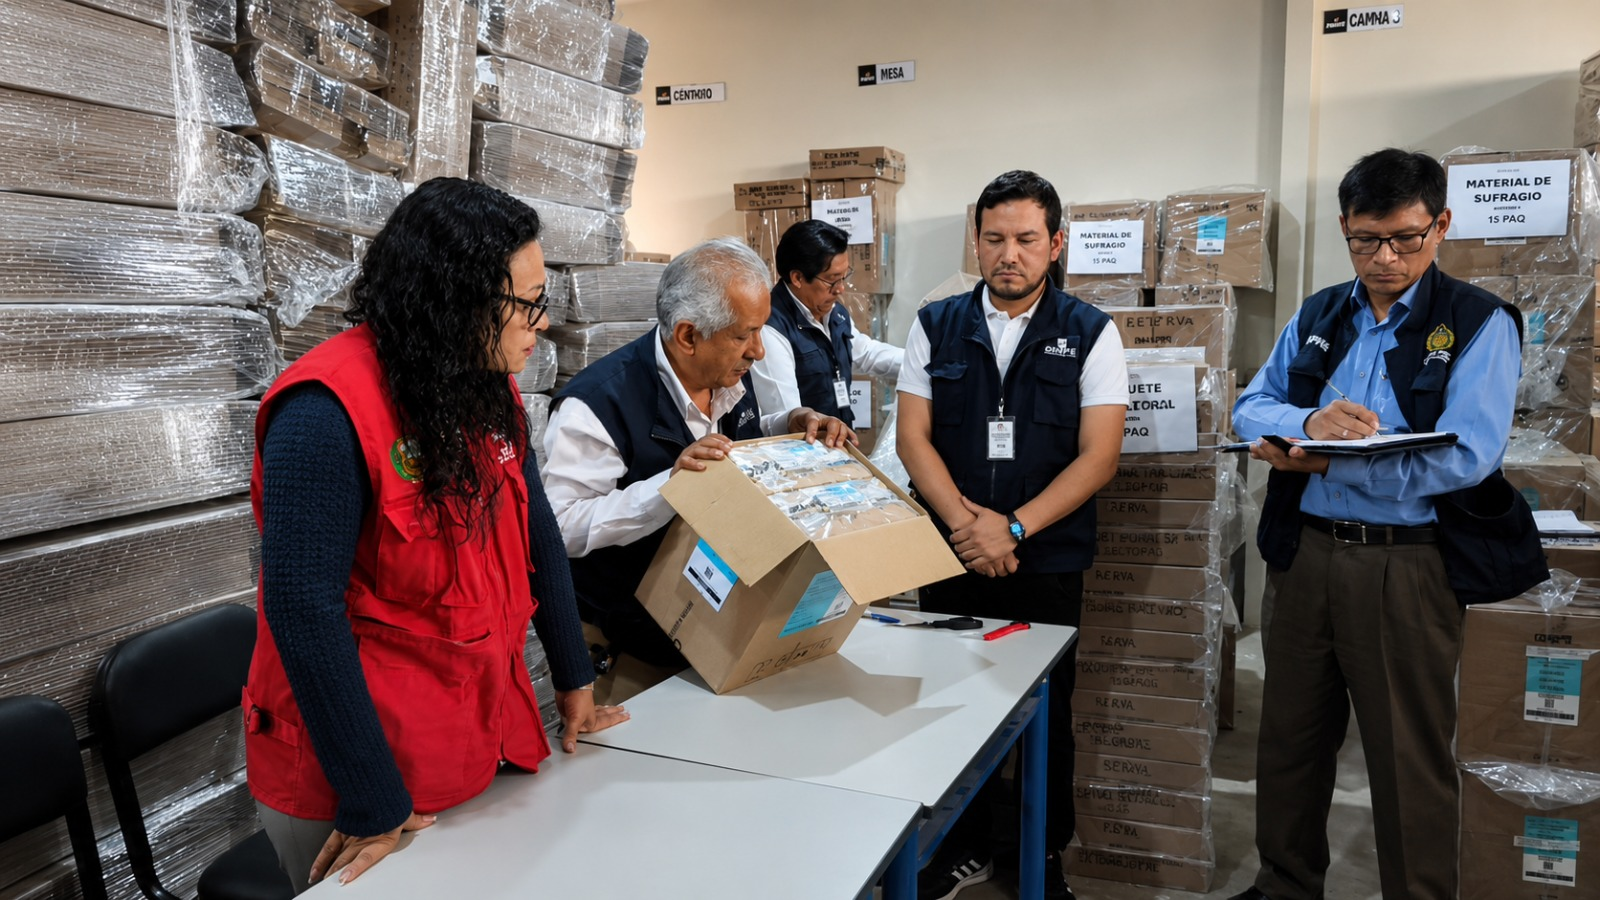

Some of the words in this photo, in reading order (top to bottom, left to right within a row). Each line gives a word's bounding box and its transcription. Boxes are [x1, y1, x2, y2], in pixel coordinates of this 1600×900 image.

[880, 66, 904, 80] MESA
[1466, 177, 1530, 189] MATERIAL
[1534, 176, 1551, 186] DE
[1474, 191, 1542, 203] SUFRAGIO
[1488, 215, 1500, 224] 15
[1502, 214, 1526, 224] PAQ
[1120, 231, 1132, 239] DE
[1128, 383, 1162, 394] UETE
[1123, 426, 1149, 437] PAQ
